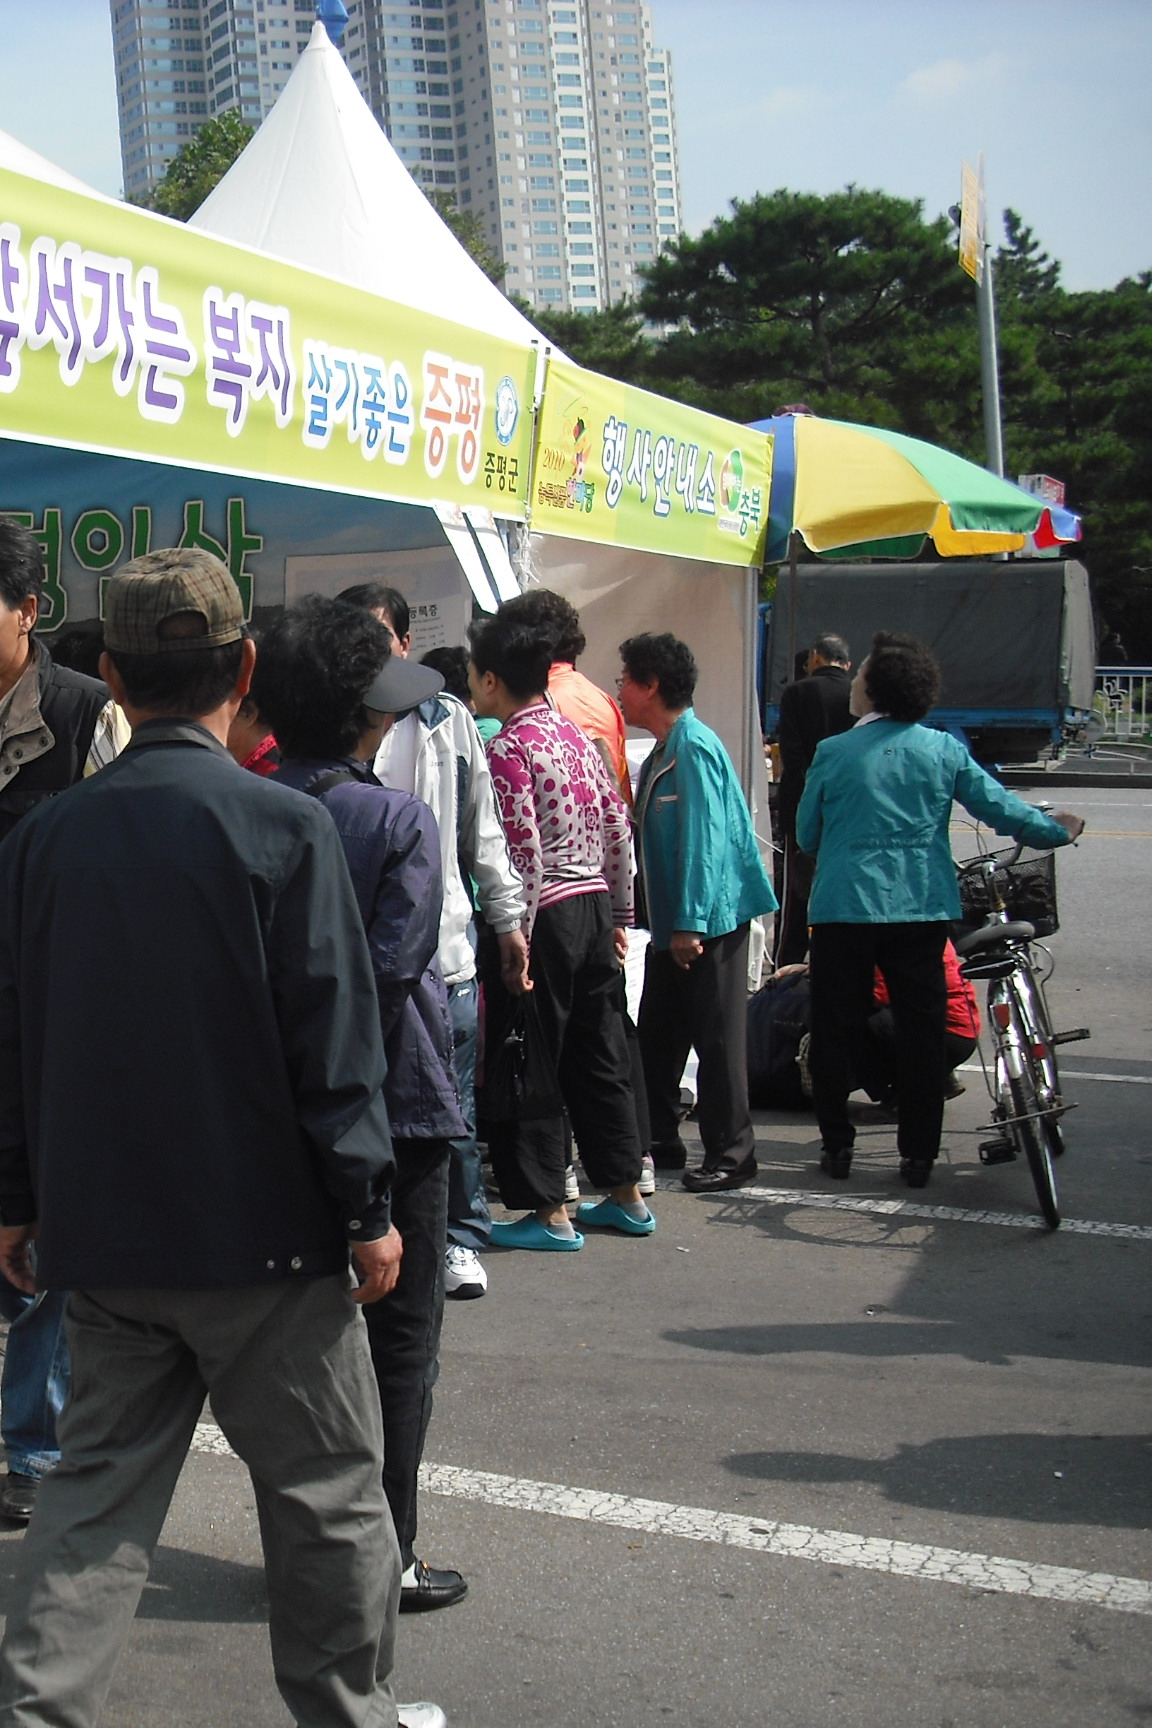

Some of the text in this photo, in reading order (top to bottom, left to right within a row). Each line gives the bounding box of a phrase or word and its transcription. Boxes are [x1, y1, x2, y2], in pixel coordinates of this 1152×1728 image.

[208, 299, 291, 425] 복지
[423, 361, 483, 476] 증평
[484, 451, 519, 493] 증평군
[542, 447, 566, 471] 2010
[601, 415, 717, 518] 행사안내소
[738, 487, 762, 537] 충북
